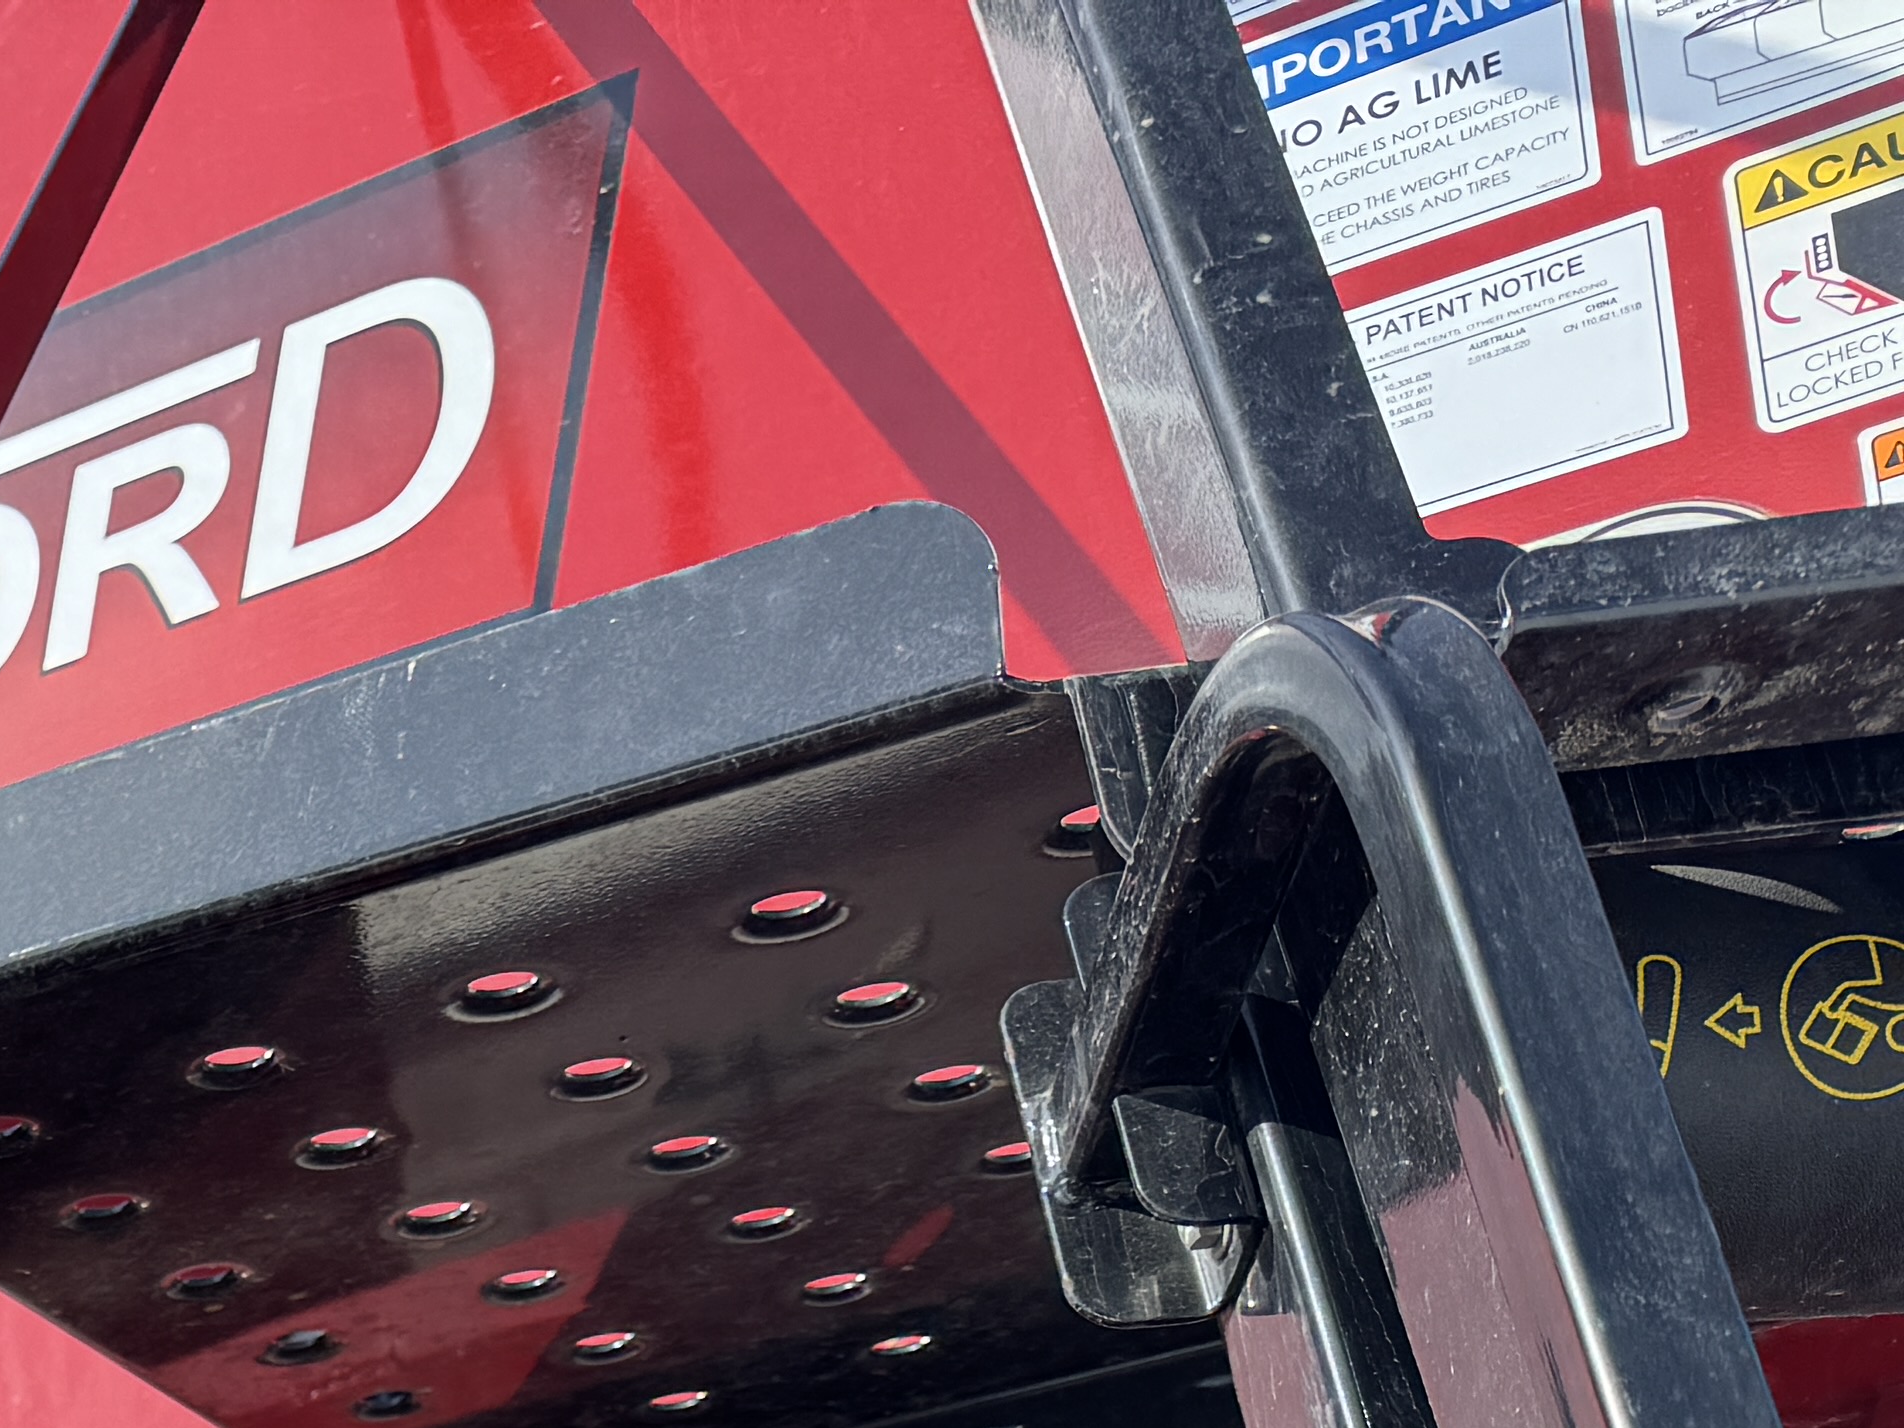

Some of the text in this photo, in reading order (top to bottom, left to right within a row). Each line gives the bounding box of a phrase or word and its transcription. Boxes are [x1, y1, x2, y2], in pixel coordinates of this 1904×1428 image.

[1294, 87, 1528, 179] ACHINE IS NOT DESIGNED
[1338, 91, 1400, 134] AG
[1415, 50, 1502, 105] LIME
[1312, 127, 1569, 227] CEED THE WEIGHT CAPACITY
[1320, 95, 1560, 192] AGRICULTURAL LIMESTONE
[1340, 204, 1415, 239] CHASSIS
[1420, 187, 1462, 213] AND
[1466, 170, 1511, 196] TIRES
[1365, 254, 1585, 345] PATENT NOTICE
[1468, 327, 1527, 351] AUSTRALIA
[1777, 360, 1883, 408] LOCKED
[1805, 328, 1898, 372] CHECK
